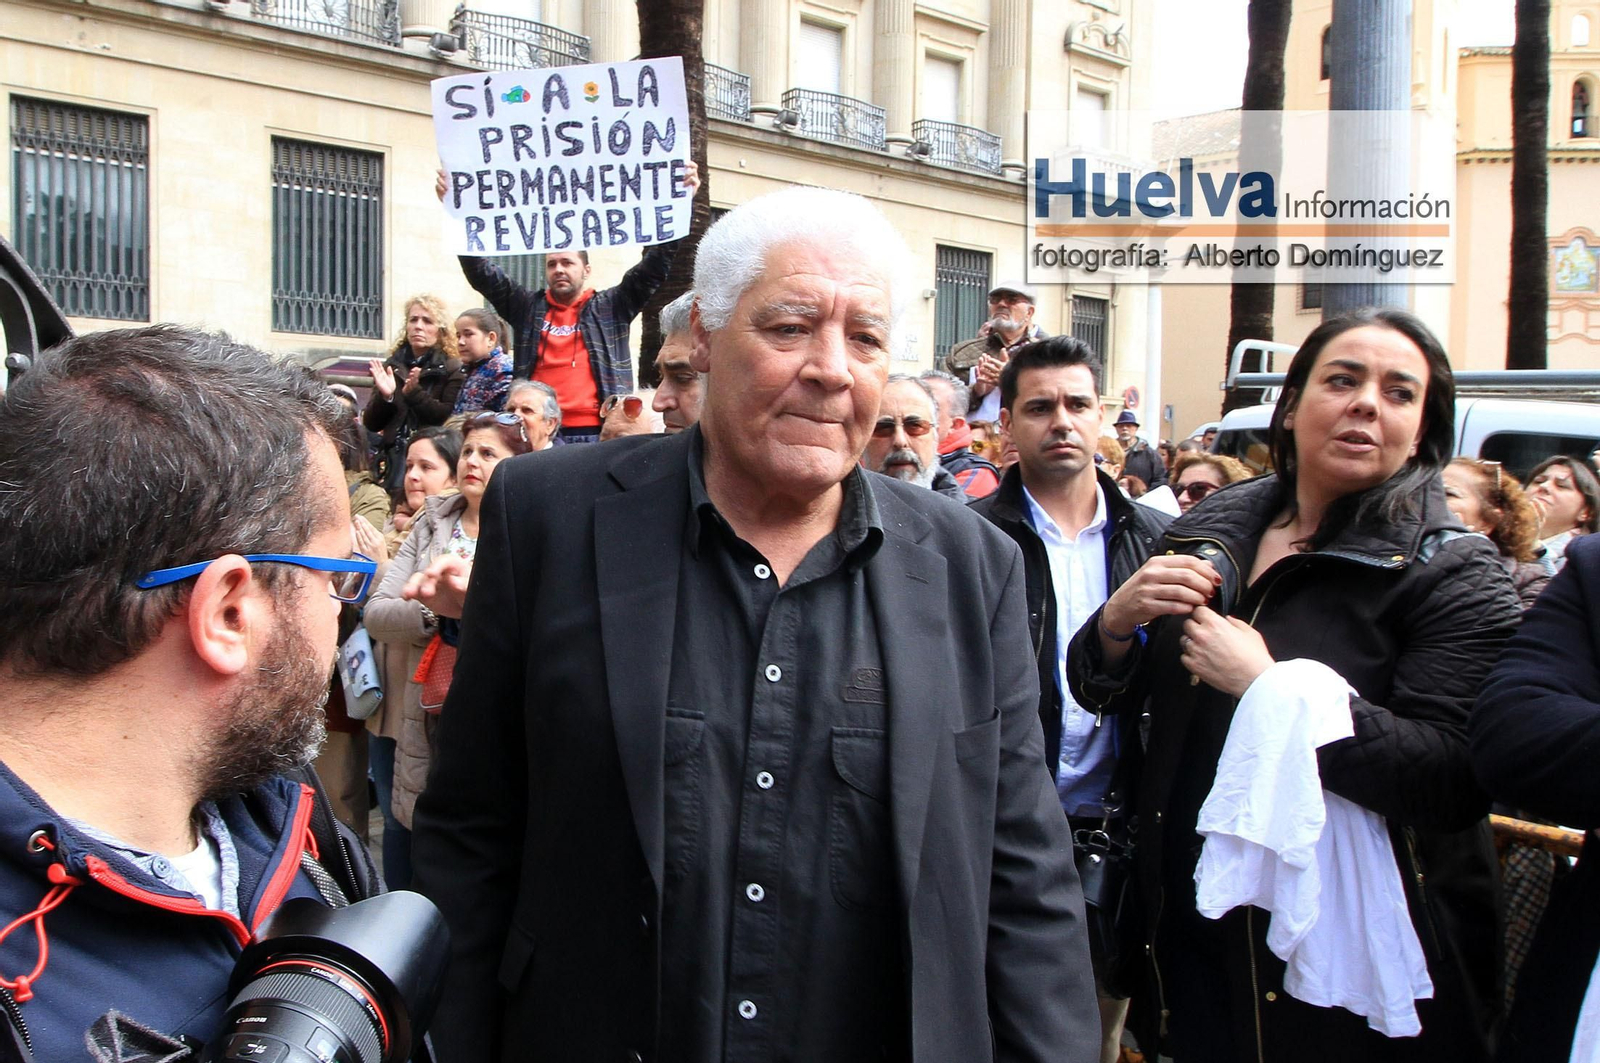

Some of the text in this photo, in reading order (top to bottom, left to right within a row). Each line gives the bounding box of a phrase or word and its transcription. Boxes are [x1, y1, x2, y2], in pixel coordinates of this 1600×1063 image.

[445, 65, 659, 118] SÍ A LA
[478, 111, 676, 164] PRISIÓN
[451, 159, 687, 210] PERMANENTE
[465, 206, 674, 251] REVISABLE
[310, 967, 334, 979] CANON
[235, 1016, 267, 1024] Canon
